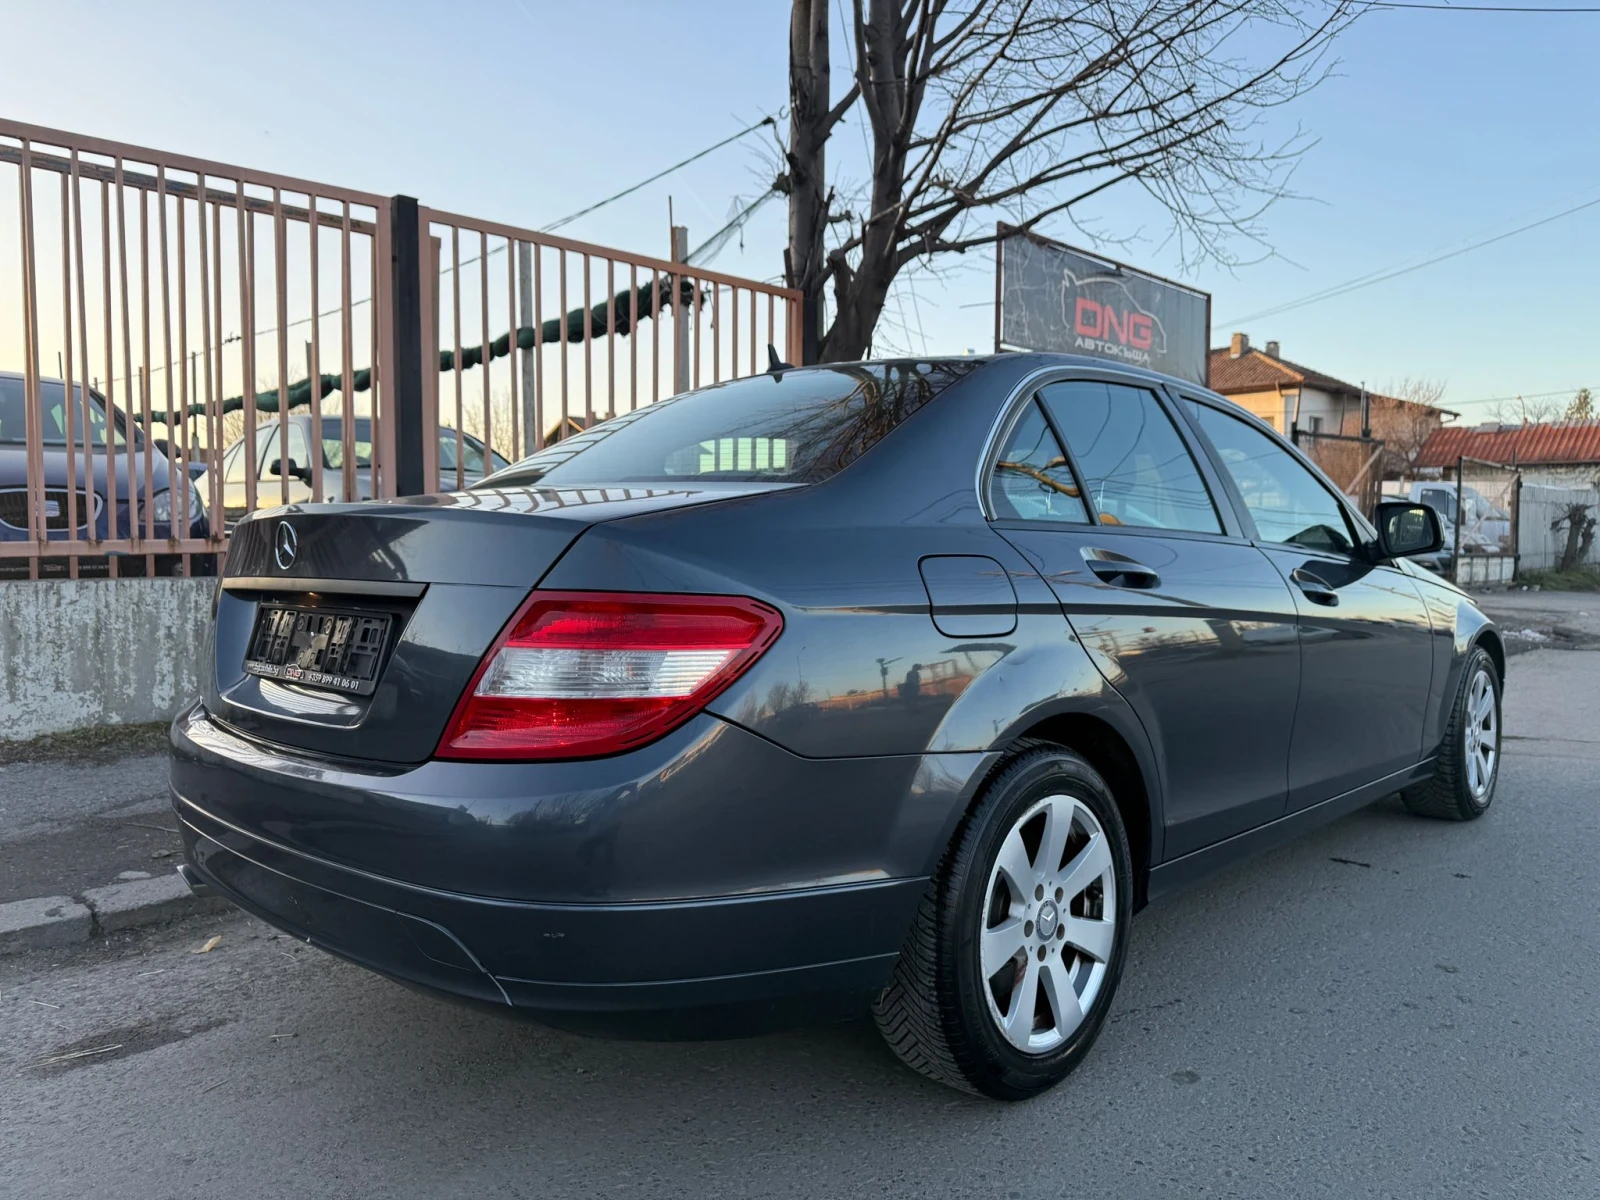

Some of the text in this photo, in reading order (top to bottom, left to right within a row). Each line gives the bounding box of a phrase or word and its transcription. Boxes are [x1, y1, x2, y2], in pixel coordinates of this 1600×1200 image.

[1075, 297, 1153, 350] DNG
[321, 674, 333, 684] 899
[333, 677, 341, 686] 41
[341, 678, 350, 688] 06
[350, 680, 359, 690] 01
